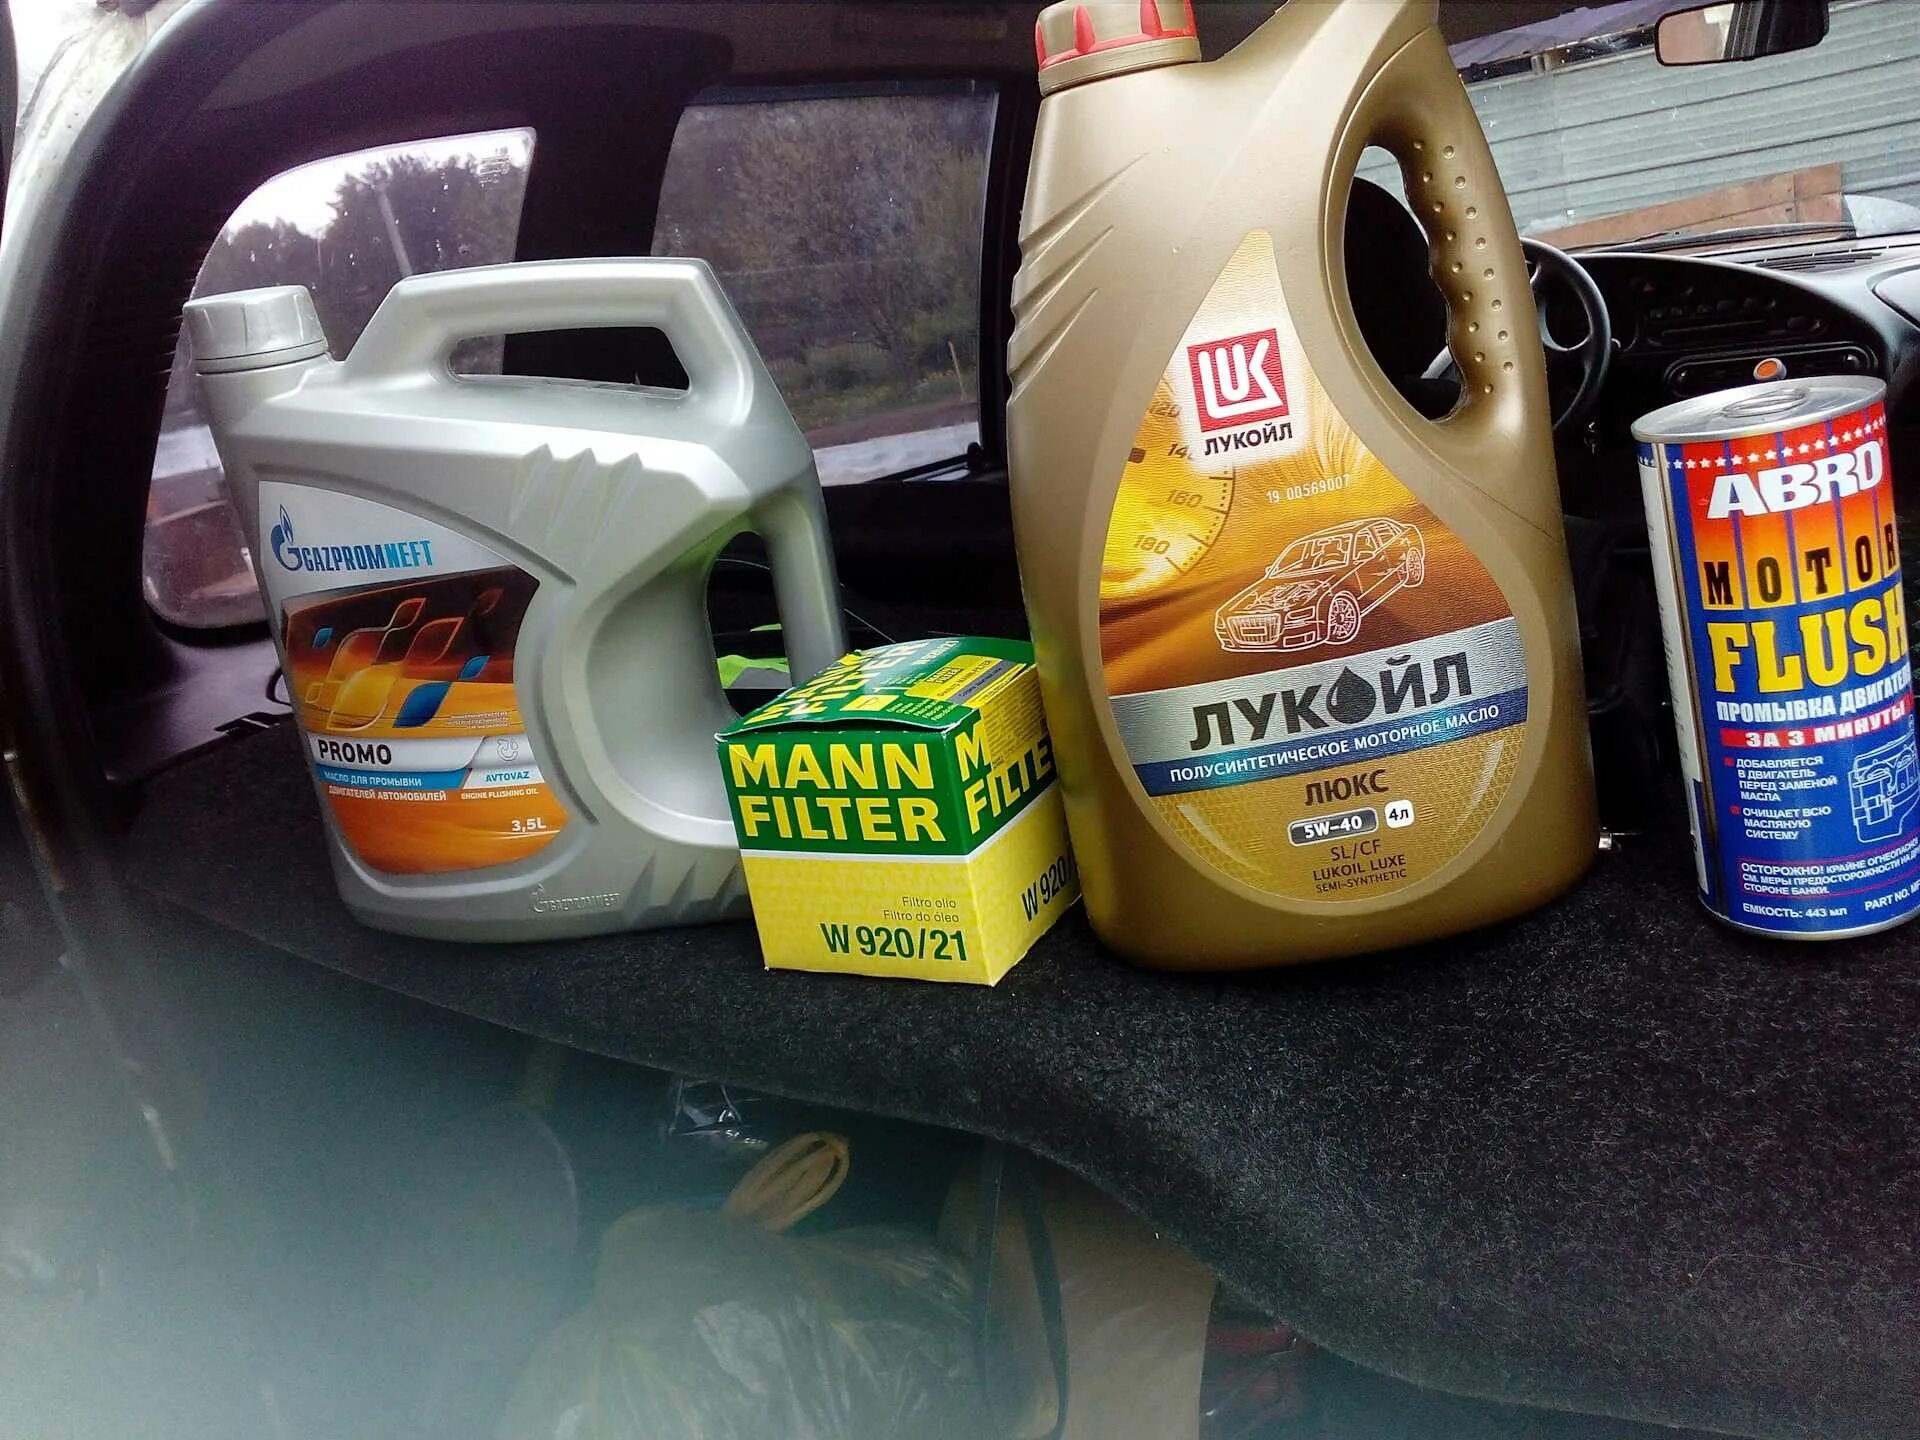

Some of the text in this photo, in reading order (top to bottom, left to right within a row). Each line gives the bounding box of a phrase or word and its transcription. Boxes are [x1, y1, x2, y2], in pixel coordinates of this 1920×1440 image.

[1204, 422, 1293, 456] ЛУКОЙЛ
[1706, 440, 1883, 520] ABRO
[1704, 523, 1896, 605] MOTOR
[1707, 583, 1908, 694] FLUSH
[1189, 653, 1473, 751] ЛУКОЙЛ
[1716, 695, 1837, 723] ПРОМЫВКА
[1746, 699, 1906, 747] ЗА 3 МИНУТЫ
[318, 739, 393, 766] PROMO
[1169, 705, 1500, 784] ПОЛУСИНТЕТИЧЕСКОЕ МОТОРНОЕ МАСЛО
[728, 743, 935, 790] MANN
[1736, 756, 1824, 769] ДОБАВЛЯЕТСЯ
[1738, 769, 1816, 780] В ДВИГАТЕЛЬ
[324, 771, 422, 787] МАСЛО ДЛЯ ПРОМЫВКИ
[485, 771, 530, 783] AVTOVAZ
[963, 735, 1054, 835] FILTE
[1305, 769, 1388, 806] ЛЮКС
[1739, 776, 1838, 791] ПЕРЕД ЗАМЕНОЙ
[328, 785, 447, 801] ДВИГАТЕЛЕЙ АВТОМОБИЛЕЙ
[488, 789, 528, 799] FLUSHING
[529, 788, 539, 796] OIL
[1741, 791, 1781, 802] МАСЛА
[738, 795, 947, 842] FILTER
[1743, 806, 1831, 818] ОЧИЩАЕТ ВСЮ
[1744, 818, 1811, 829] МАСЛЯНУЮ
[511, 818, 546, 832] 3,5L
[1304, 815, 1362, 839] 5W-40
[1746, 830, 1799, 840] СИСТЕМУ
[1331, 839, 1382, 862] SL/CF
[1313, 854, 1406, 881] LUKOIL LUXE
[1741, 863, 1824, 876] ОСТОРОЖНО!
[1826, 860, 1866, 874] КРАЙНЕ
[1743, 874, 1759, 883] СМ.
[1760, 875, 1792, 885] МЕРЫ
[1794, 860, 1900, 885] ПРЕДОСТОРОЖНОСТИ
[1316, 869, 1407, 894] SEMI-SYNTHETIC
[1744, 884, 1789, 895] СТОРОНЕ
[902, 896, 957, 909] Filtro olio
[1021, 883, 1039, 922] W
[1743, 902, 1848, 919] ЕМКОСТЬ: 443 мл
[1864, 895, 1895, 912] PART
[1894, 888, 1910, 903] NO.
[883, 907, 960, 923] Filtro do óleo
[821, 922, 968, 961] W 920/21
